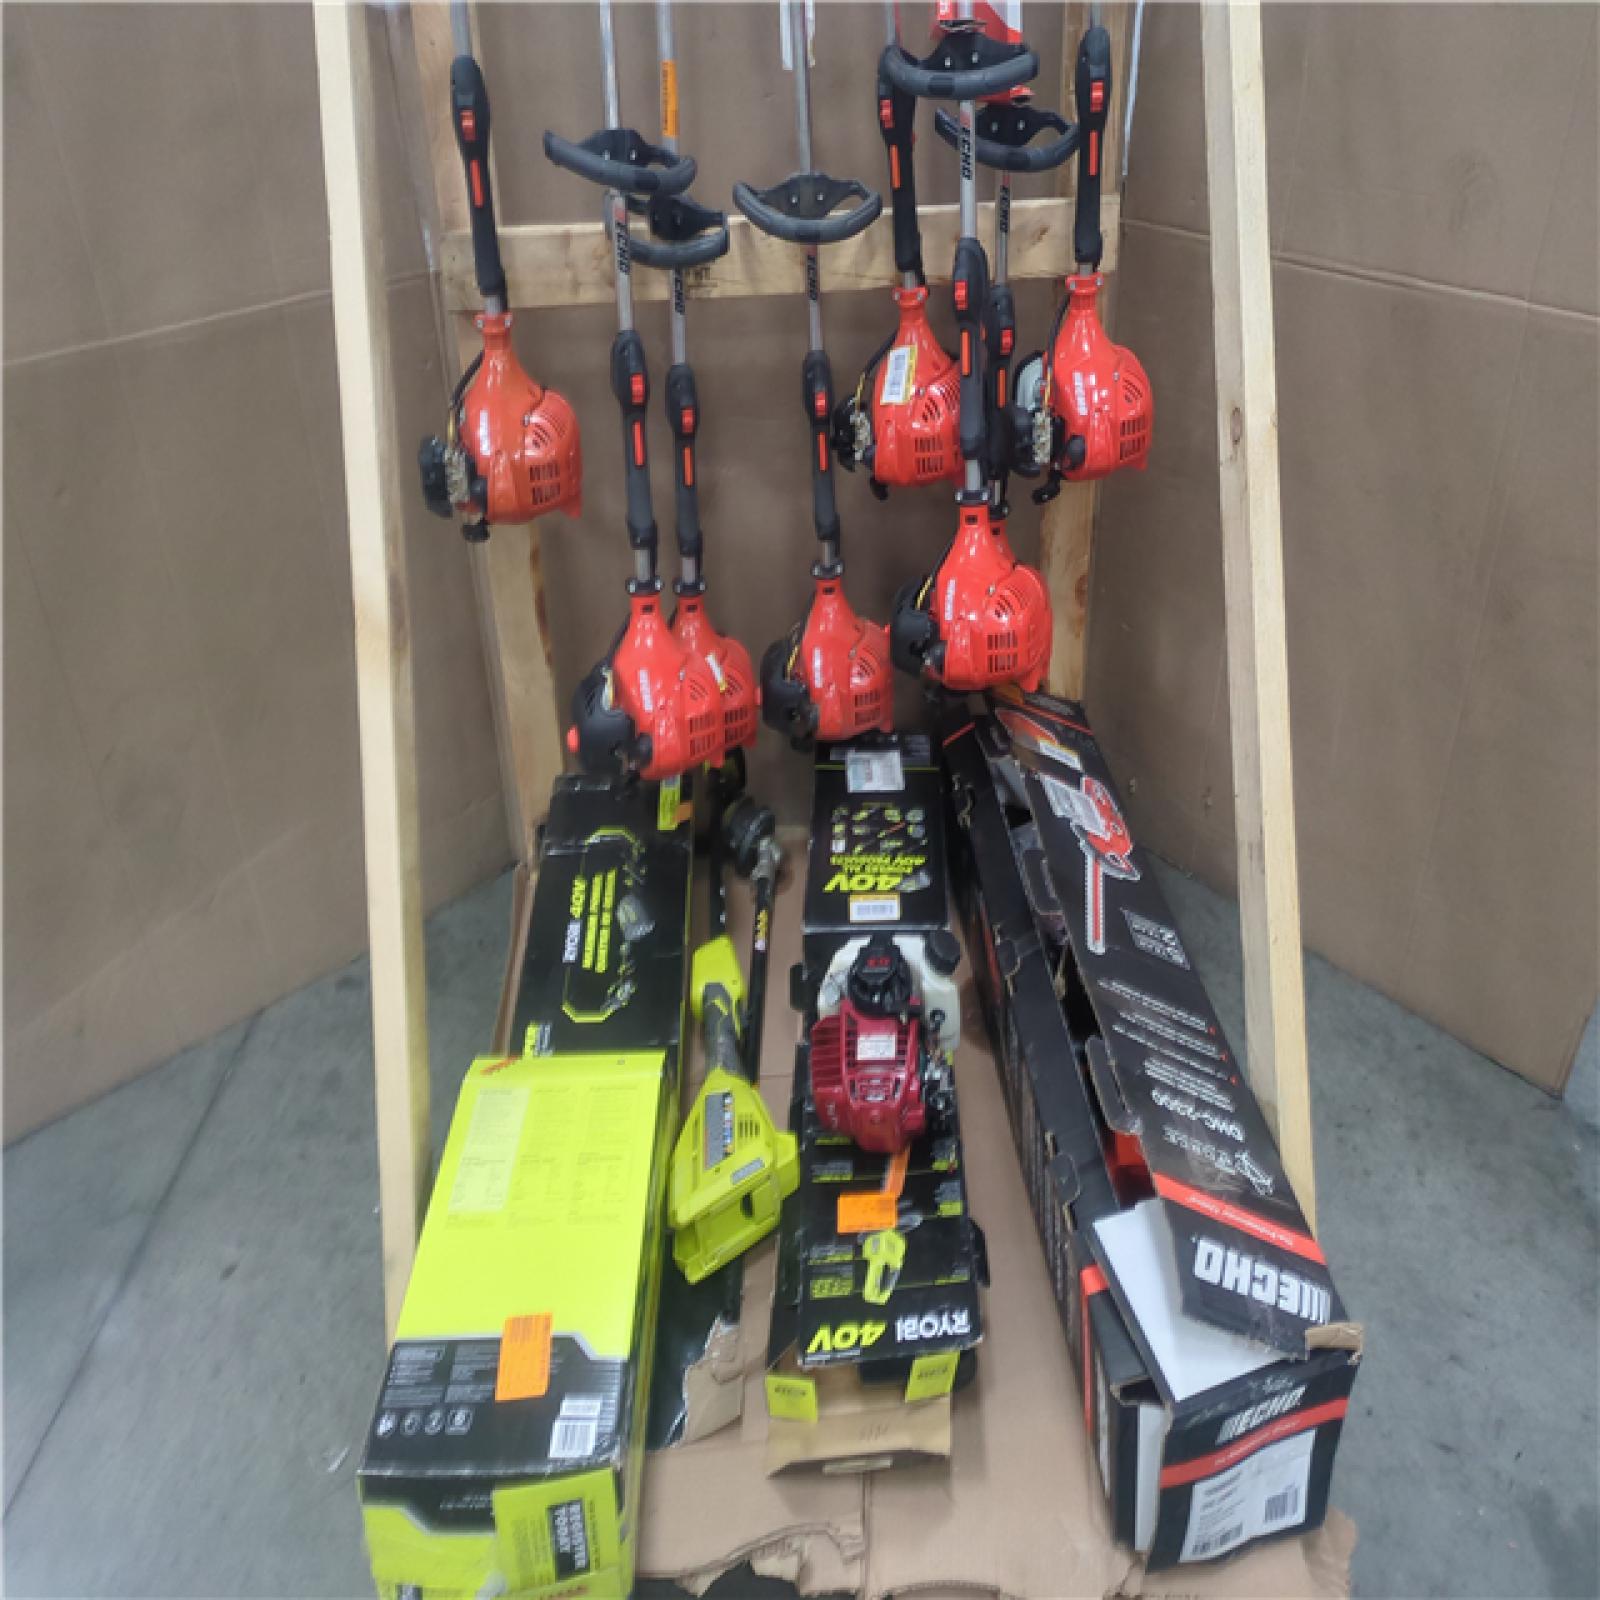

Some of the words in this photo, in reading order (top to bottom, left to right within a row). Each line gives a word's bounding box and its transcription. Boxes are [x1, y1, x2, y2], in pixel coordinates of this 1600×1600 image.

[960, 127, 972, 180] ECHO
[615, 222, 630, 275] ECHO
[823, 872, 901, 892] 40V
[1194, 1238, 1301, 1316] ECHO
[806, 1321, 887, 1354] 40V
[896, 1309, 971, 1343] RYOBI
